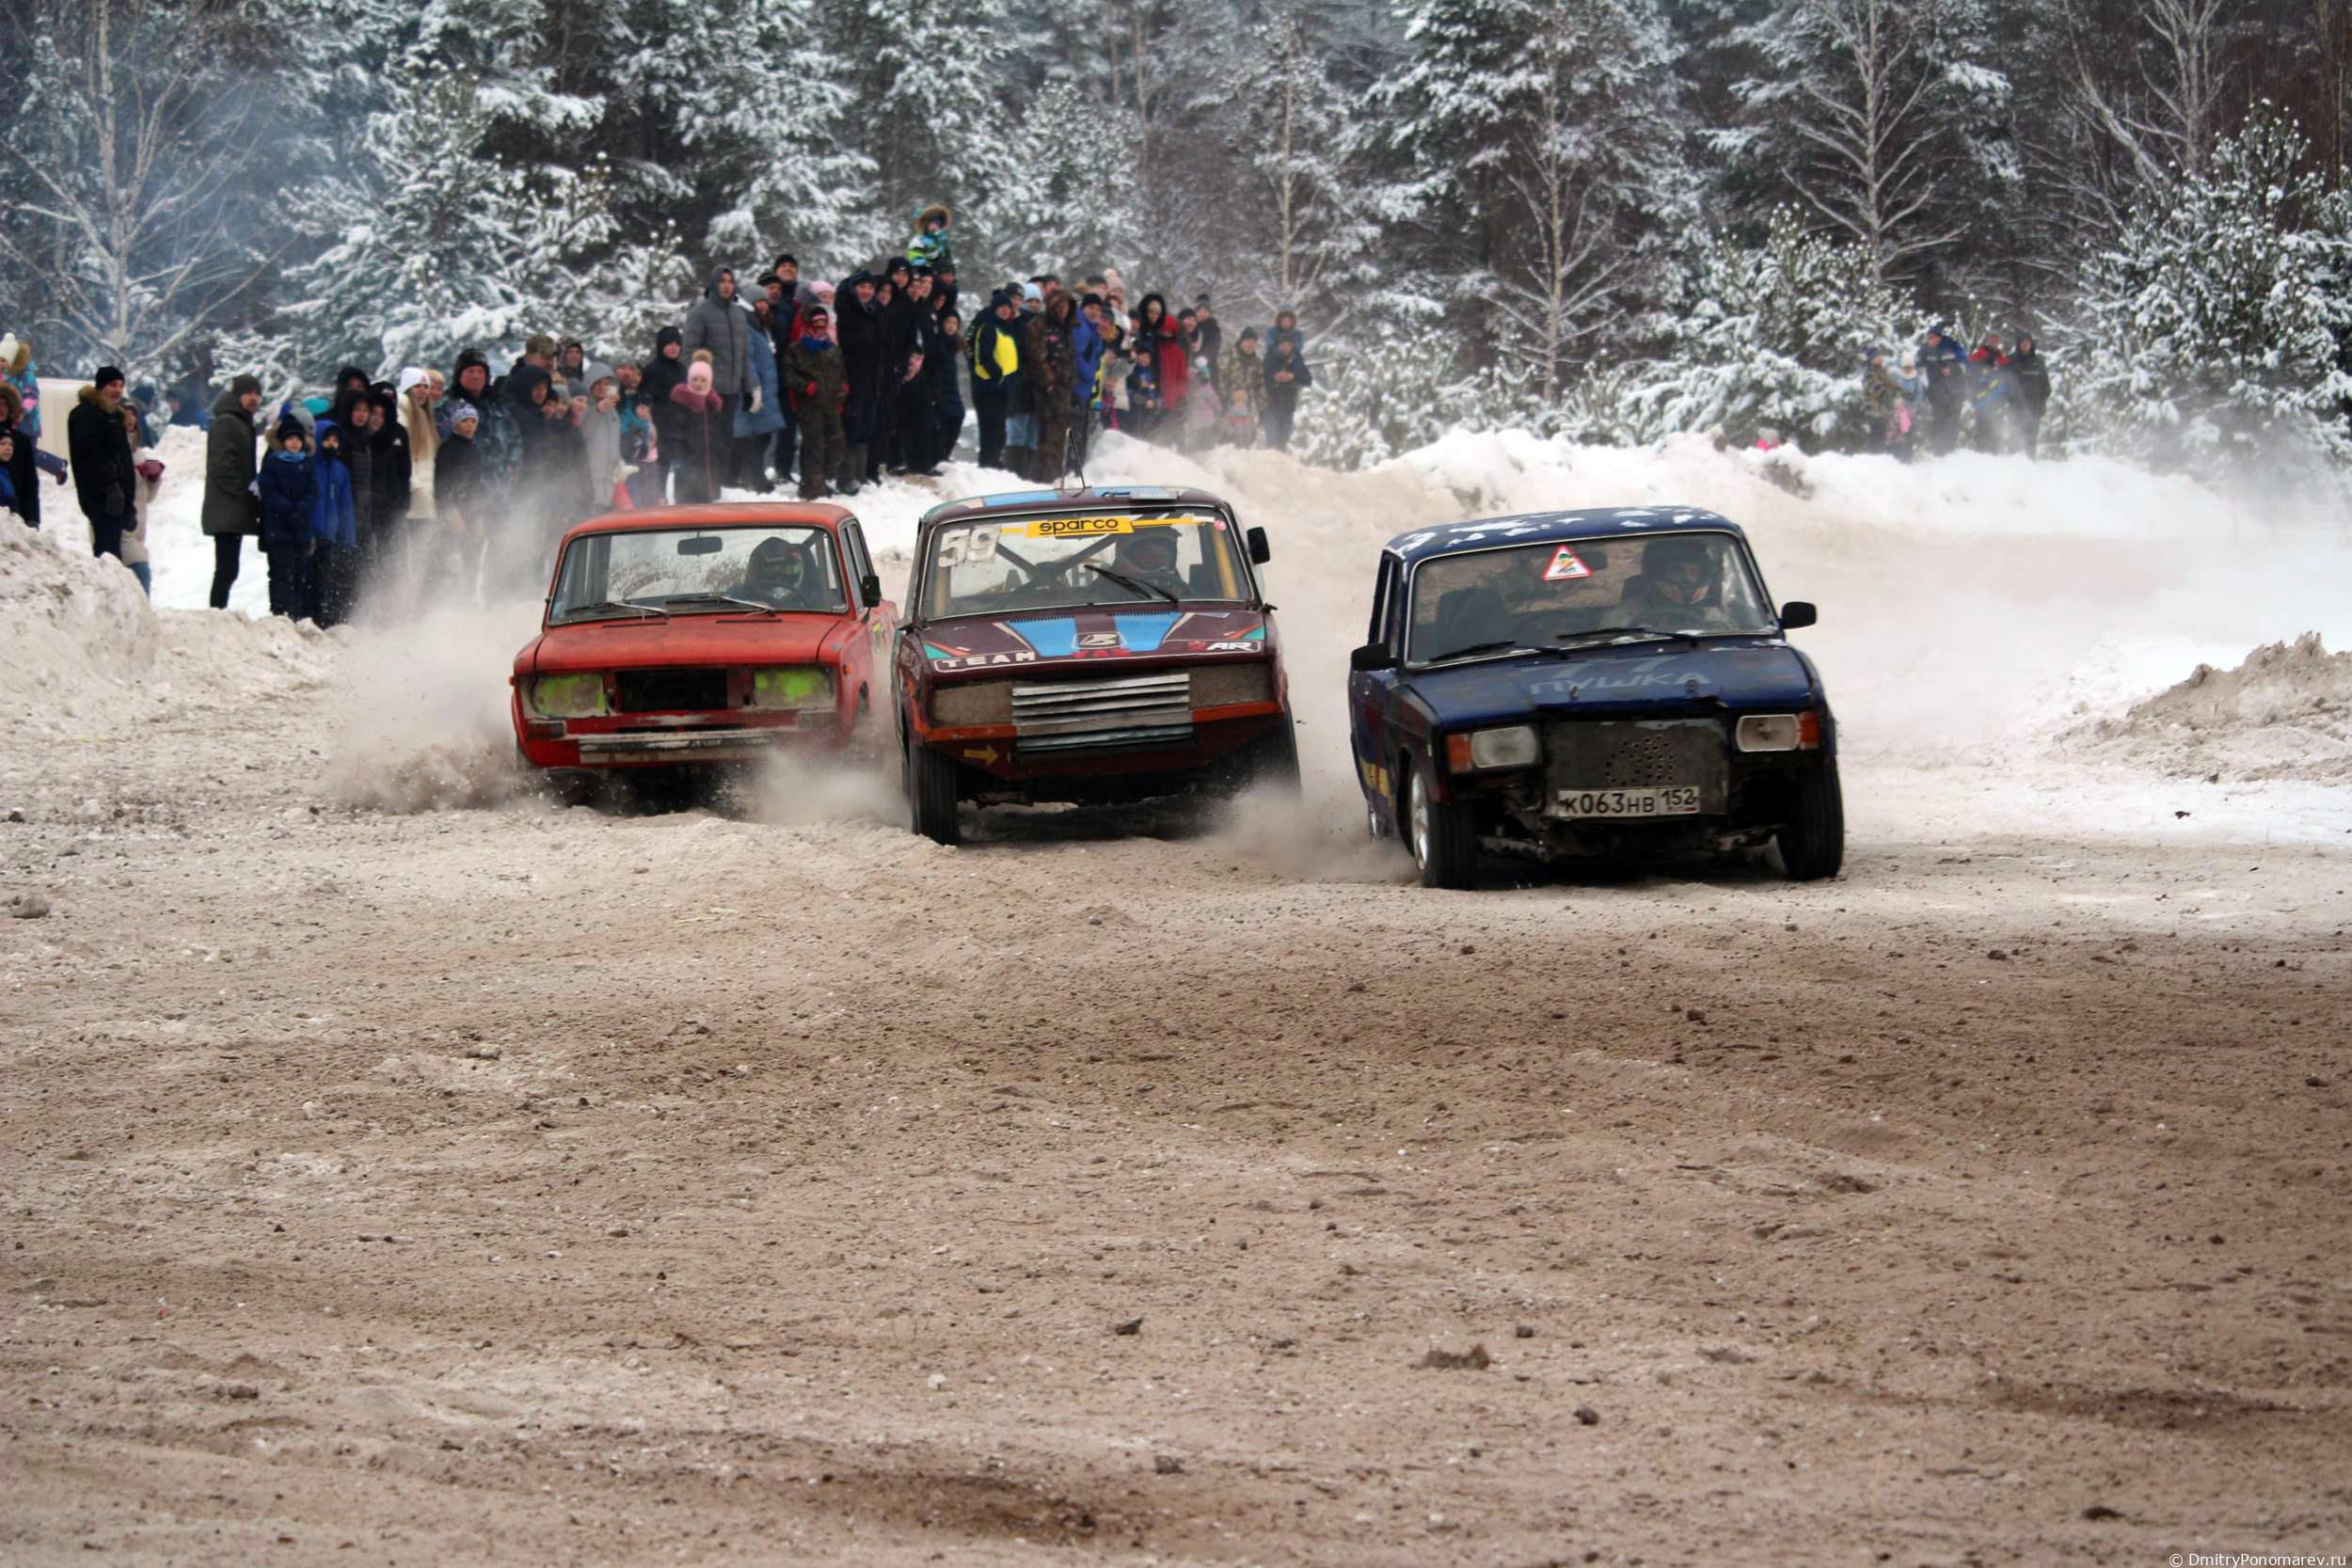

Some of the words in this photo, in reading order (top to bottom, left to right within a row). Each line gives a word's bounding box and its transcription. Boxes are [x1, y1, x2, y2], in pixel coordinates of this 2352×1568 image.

[1039, 517, 1120, 535] sparco
[938, 526, 998, 567] 59
[941, 651, 1036, 668] TEAM
[1530, 672, 1711, 695] ПУШКА
[1661, 788, 1697, 806] 152
